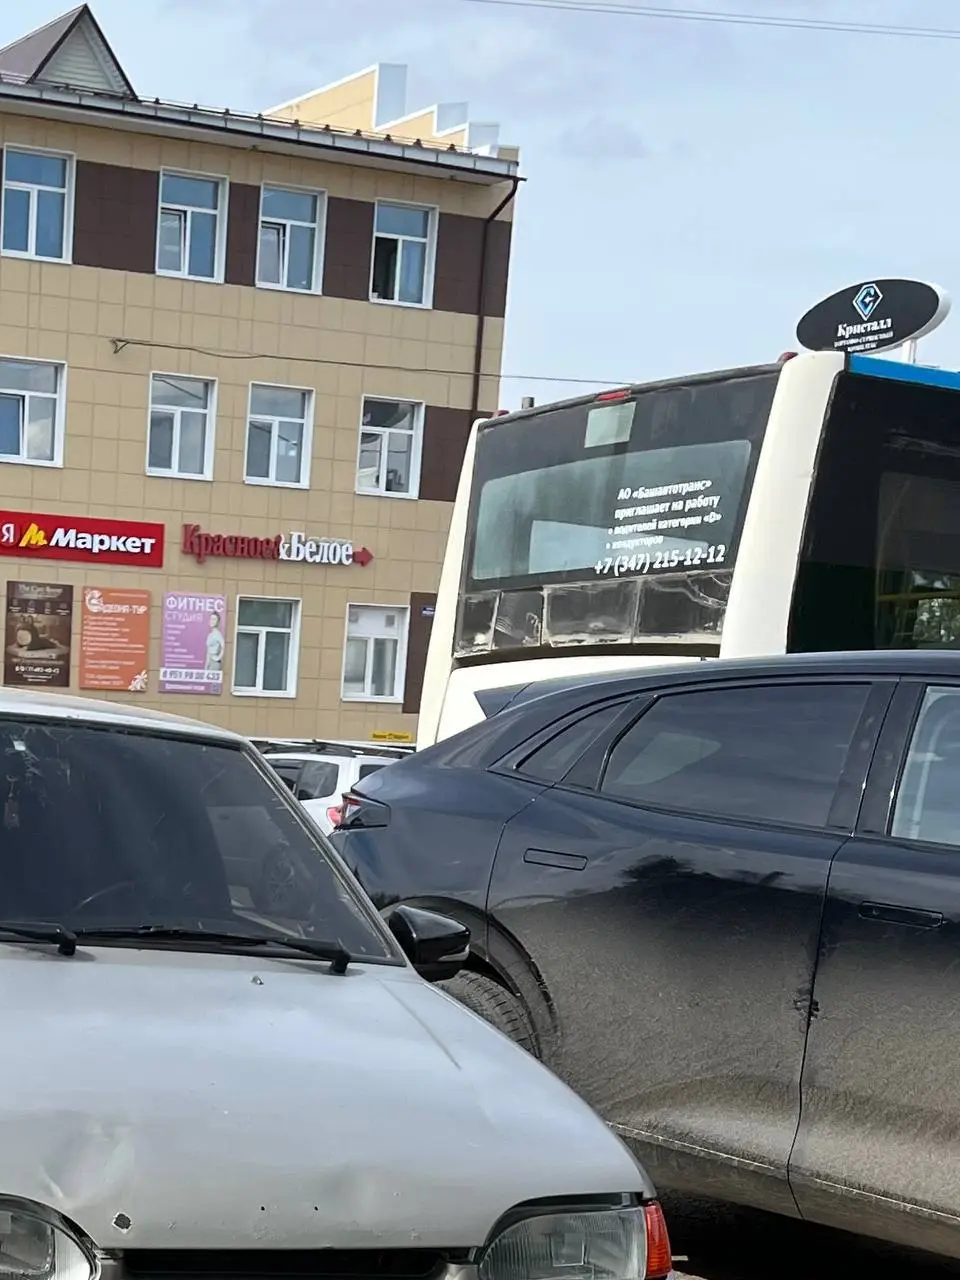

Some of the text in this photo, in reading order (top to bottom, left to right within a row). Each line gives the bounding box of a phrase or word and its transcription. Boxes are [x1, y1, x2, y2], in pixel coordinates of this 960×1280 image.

[837, 318, 892, 338] Кристалл
[617, 487, 632, 500] АО
[614, 495, 720, 520] приглашает на работу
[1, 523, 15, 543] Я
[49, 527, 156, 554] Маркет
[594, 544, 726, 576] +7 (347) 215-12-12
[166, 596, 224, 612] ФИТНЕС
[165, 611, 203, 622] СТУДИЯ
